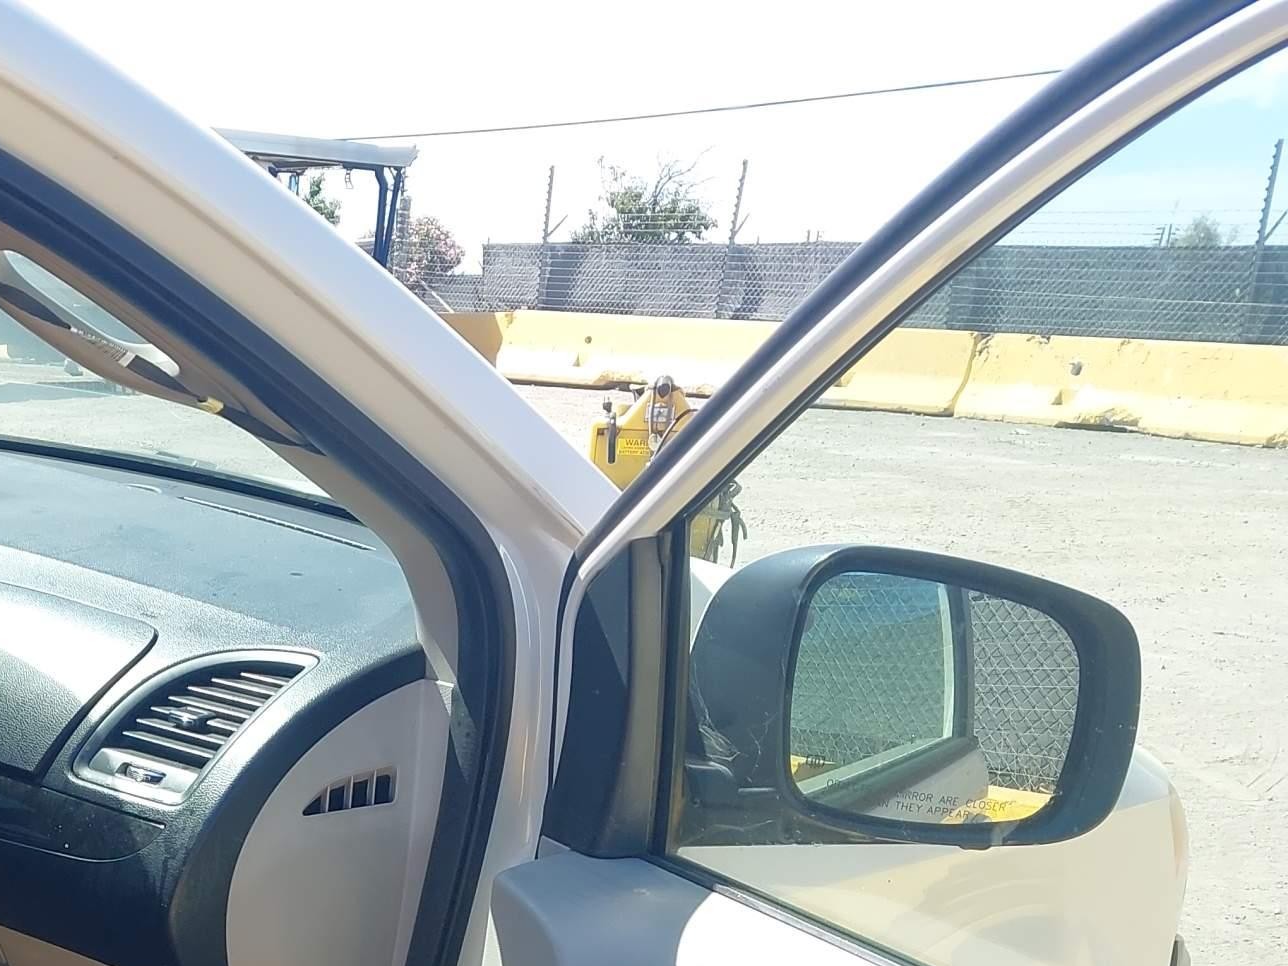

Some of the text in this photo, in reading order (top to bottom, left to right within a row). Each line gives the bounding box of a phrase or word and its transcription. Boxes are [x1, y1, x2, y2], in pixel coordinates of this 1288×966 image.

[895, 800, 924, 813] THEY
[926, 806, 970, 819] APPEAR
[939, 795, 959, 807] ARE
[965, 799, 1008, 812] CLOSER
